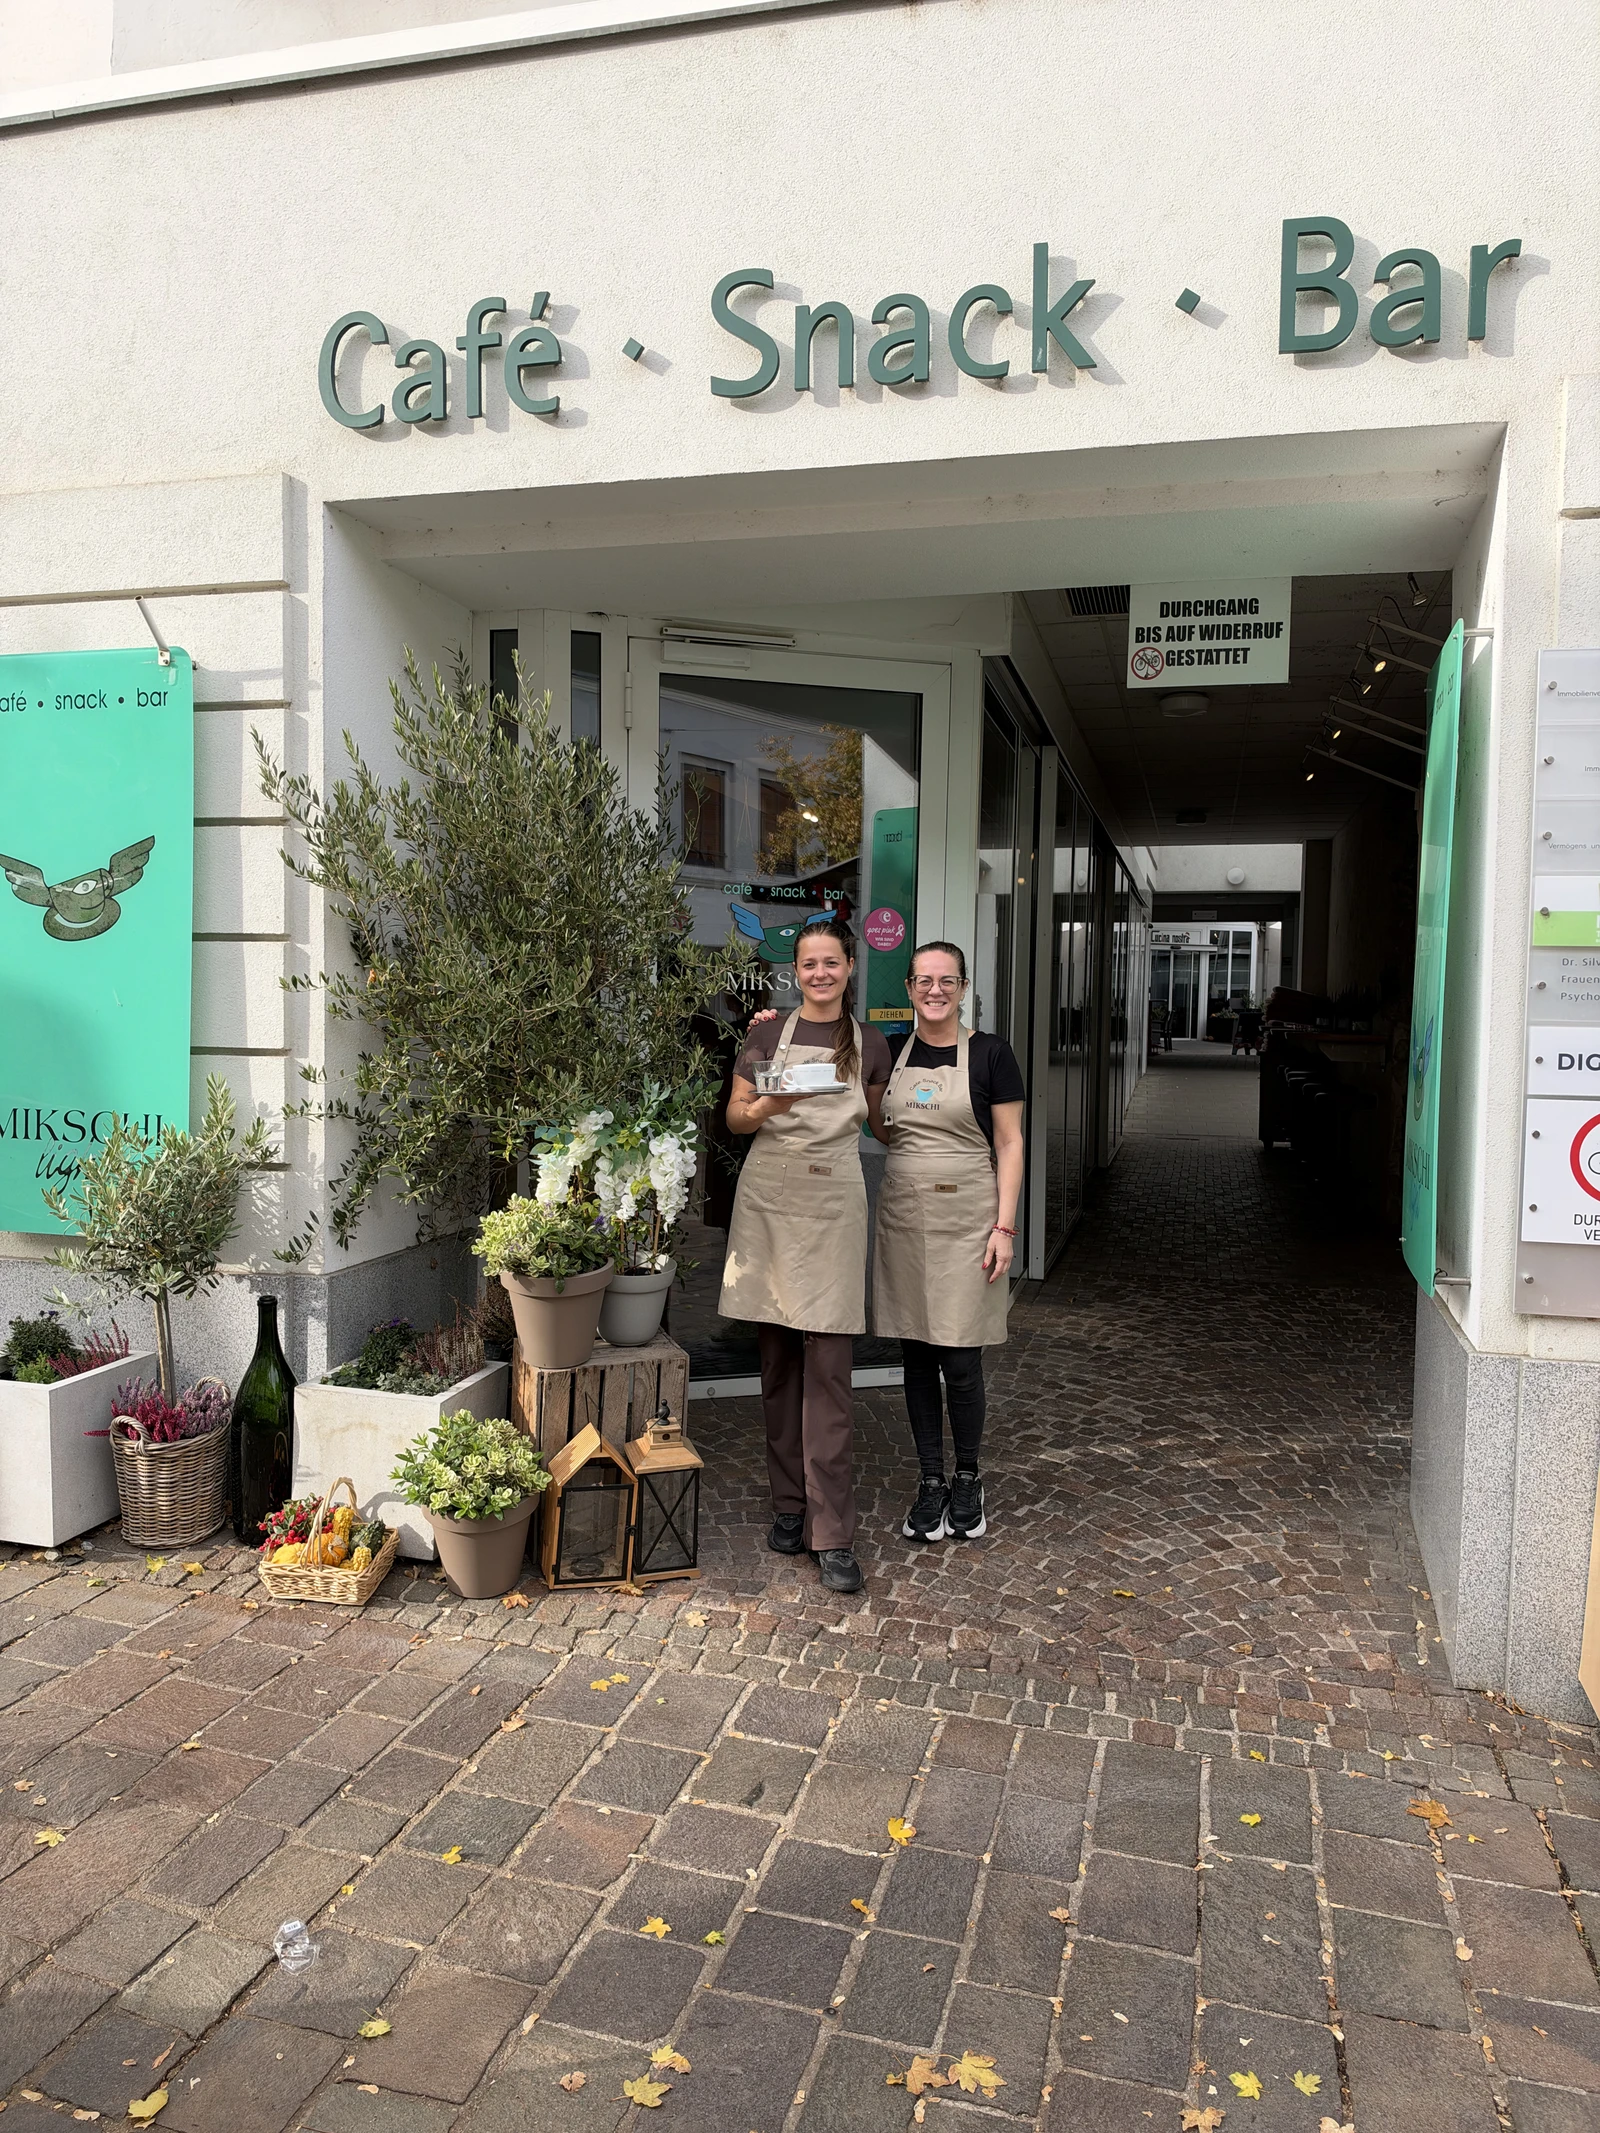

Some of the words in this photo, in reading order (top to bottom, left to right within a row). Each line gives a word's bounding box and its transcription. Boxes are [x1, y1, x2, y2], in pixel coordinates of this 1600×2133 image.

[318, 292, 562, 429] Café
[711, 242, 1097, 398] Snack
[1279, 216, 1522, 354] Bar
[1159, 598, 1260, 618] DURCHGANG
[1135, 626, 1162, 643] BIS
[1165, 625, 1195, 642] AUF
[1199, 621, 1284, 641] WIDERRUF
[1165, 647, 1250, 667] GESTATTET
[55, 689, 108, 710] snack
[137, 687, 168, 707] bar
[723, 882, 752, 895] café
[770, 886, 807, 899] snack
[823, 887, 845, 900] bar
[1562, 957, 1578, 966] Dr.
[879, 1010, 904, 1019] ZIEHEN
[905, 1101, 940, 1110] MIKSCHI
